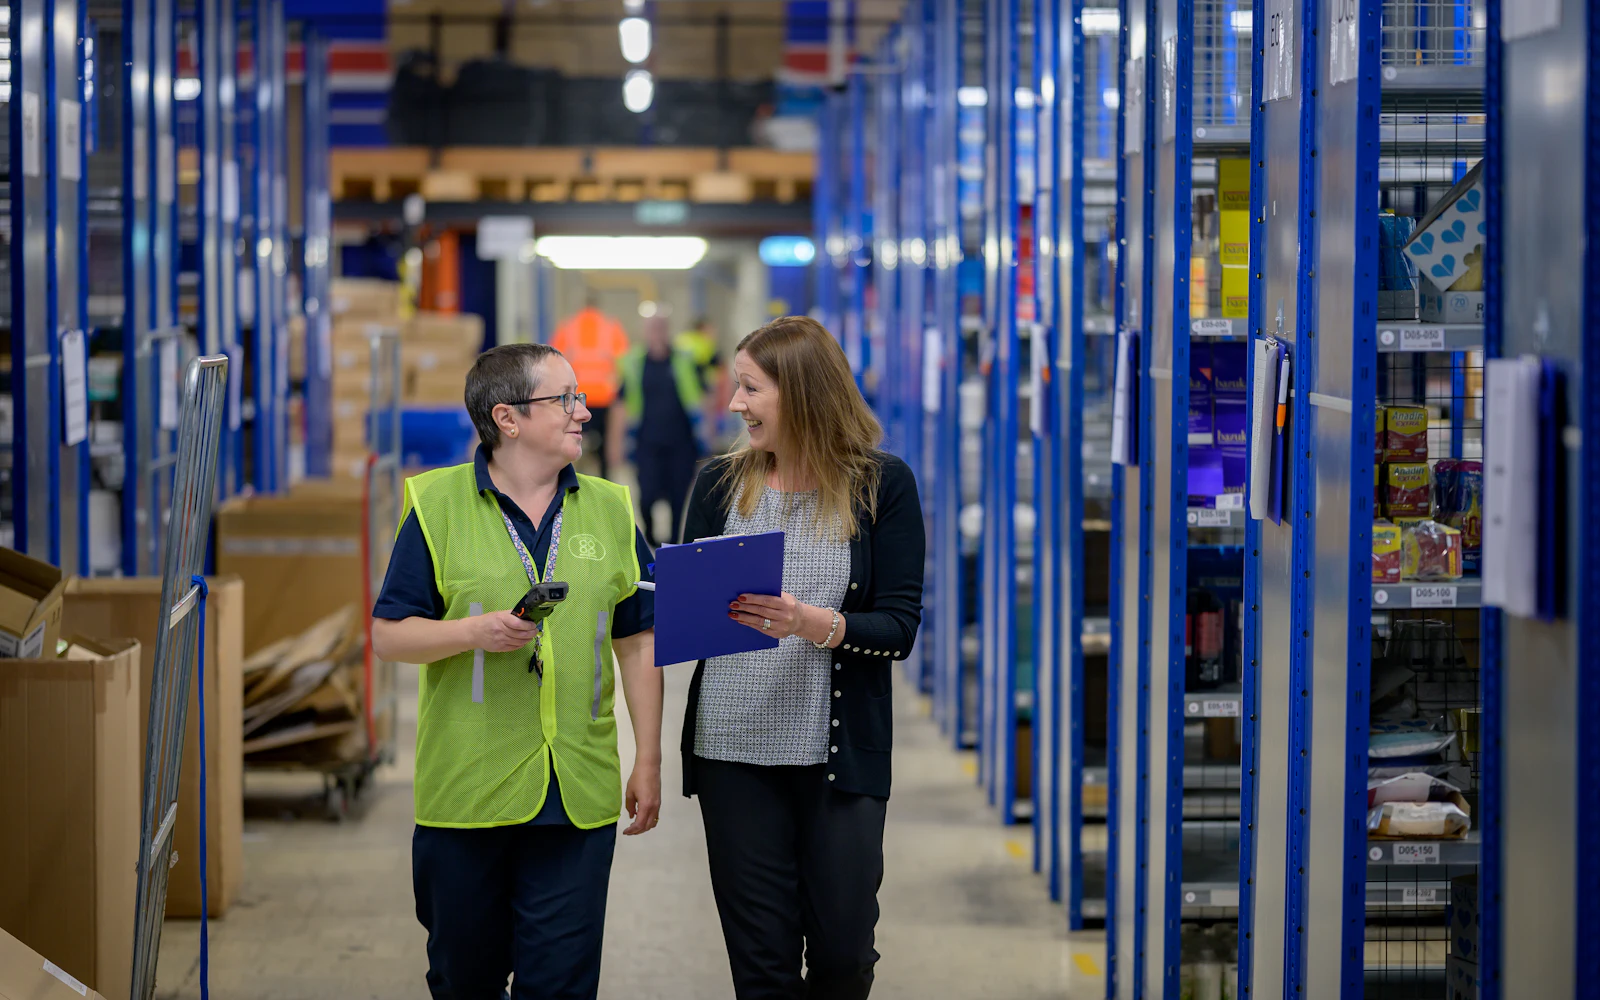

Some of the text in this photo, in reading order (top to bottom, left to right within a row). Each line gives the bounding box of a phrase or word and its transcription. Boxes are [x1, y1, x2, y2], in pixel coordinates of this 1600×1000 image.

[1201, 320, 1227, 328] E05-050
[1404, 330, 1440, 340] D05-050
[1392, 411, 1424, 420] Anadin
[1394, 466, 1425, 475] Anadin
[1416, 588, 1451, 598] D05-100
[1208, 702, 1233, 710] E05-150
[1399, 846, 1433, 855] D05-150
